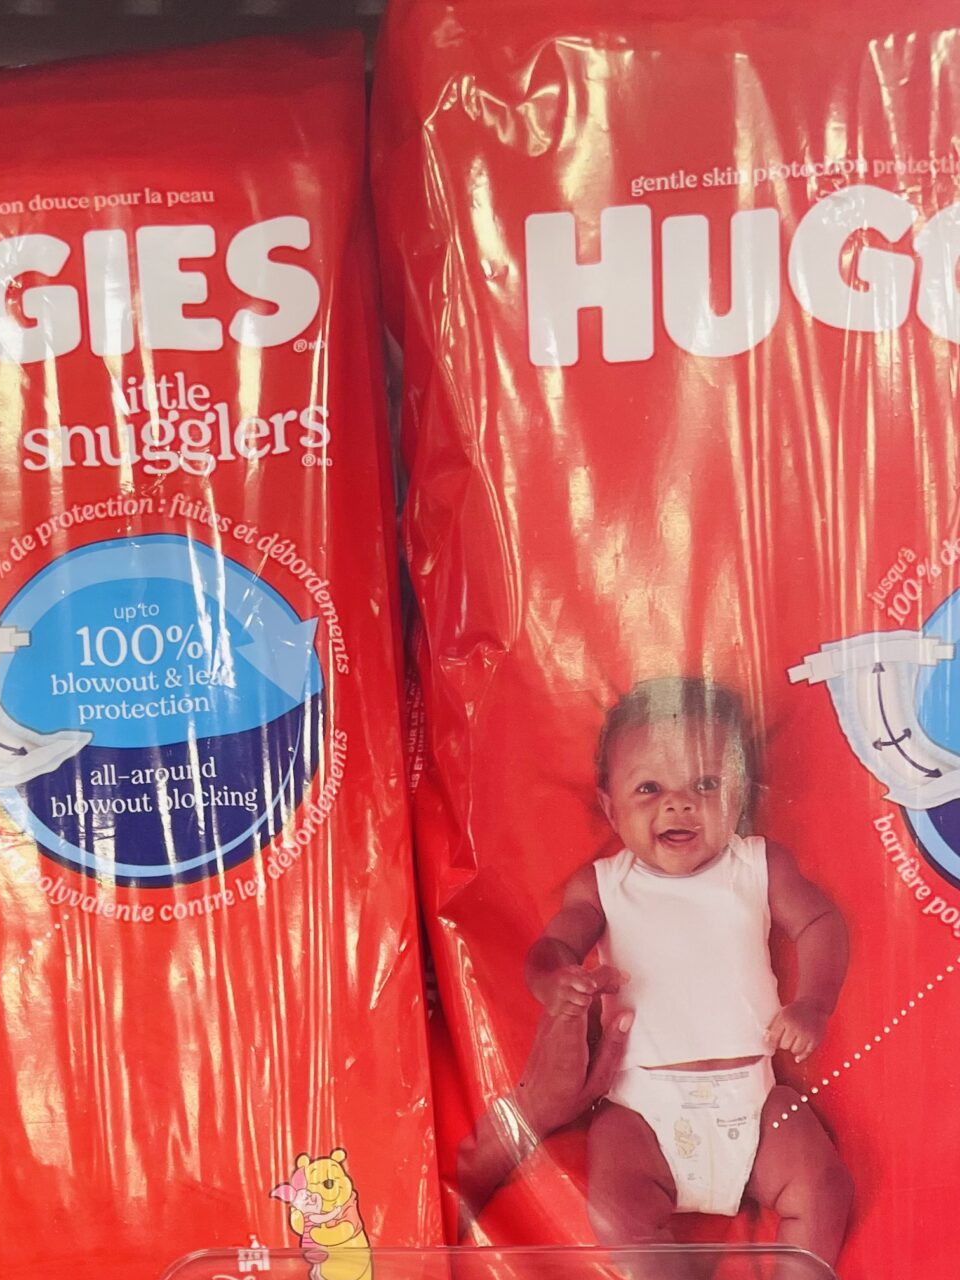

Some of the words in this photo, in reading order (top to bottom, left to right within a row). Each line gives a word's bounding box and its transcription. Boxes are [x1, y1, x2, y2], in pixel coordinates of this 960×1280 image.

[29, 193, 89, 212] douce
[94, 189, 140, 211] pour
[144, 187, 162, 205] la
[167, 189, 214, 207] peau
[631, 170, 698, 197] gentle
[23, 402, 330, 476] snugglers
[10, 536, 36, 562] de
[35, 495, 153, 546] protection
[168, 493, 232, 533] fuites
[233, 524, 259, 544] et
[257, 533, 350, 675] débordements
[114, 606, 136, 623] up
[138, 603, 160, 618] to
[887, 578, 922, 626] 100
[76, 623, 203, 667] 100%
[51, 671, 159, 696] blowout
[165, 667, 182, 688] &
[79, 694, 211, 725] protection
[51, 793, 152, 818] blowout
[873, 813, 932, 900] barrière
[160, 888, 235, 922] contre
